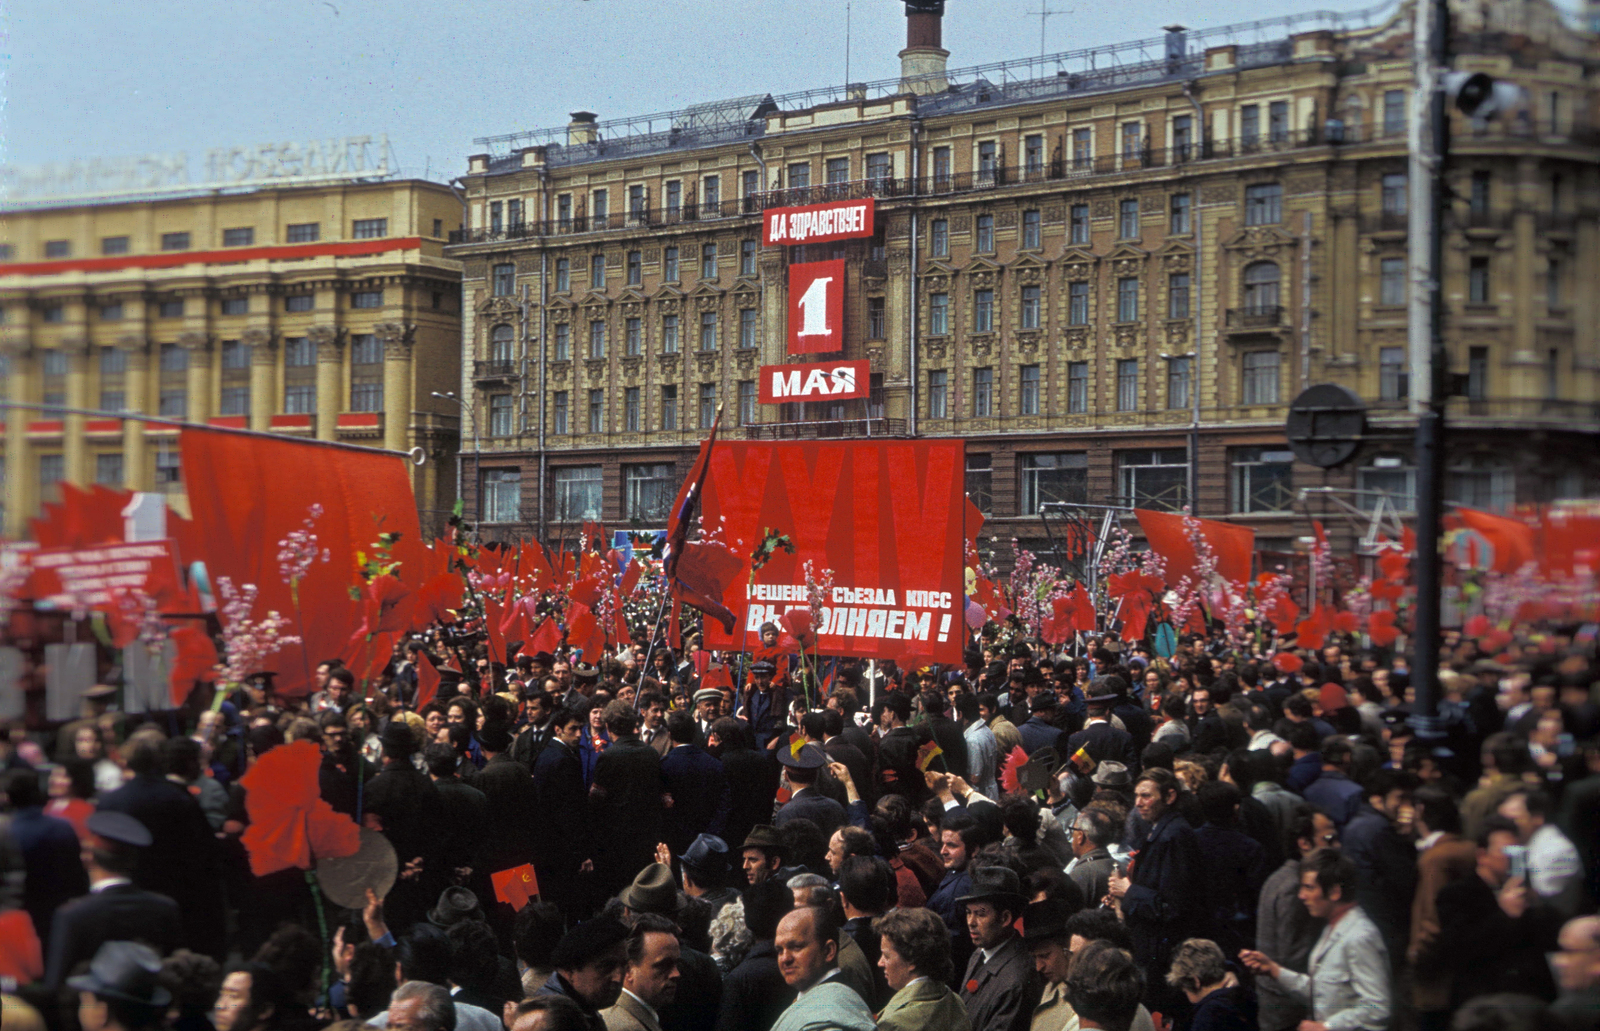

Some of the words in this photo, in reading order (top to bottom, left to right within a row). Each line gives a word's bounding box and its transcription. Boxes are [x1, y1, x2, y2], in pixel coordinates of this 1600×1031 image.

[769, 214, 787, 242] ДА
[789, 205, 867, 241] ЗДРАВСТВУЕТ
[797, 276, 833, 337] 1
[772, 366, 856, 398] МАЯ
[746, 584, 824, 602] РЕШЕН
[832, 586, 896, 606] СЪЕЗДА
[906, 590, 952, 609] КПСС
